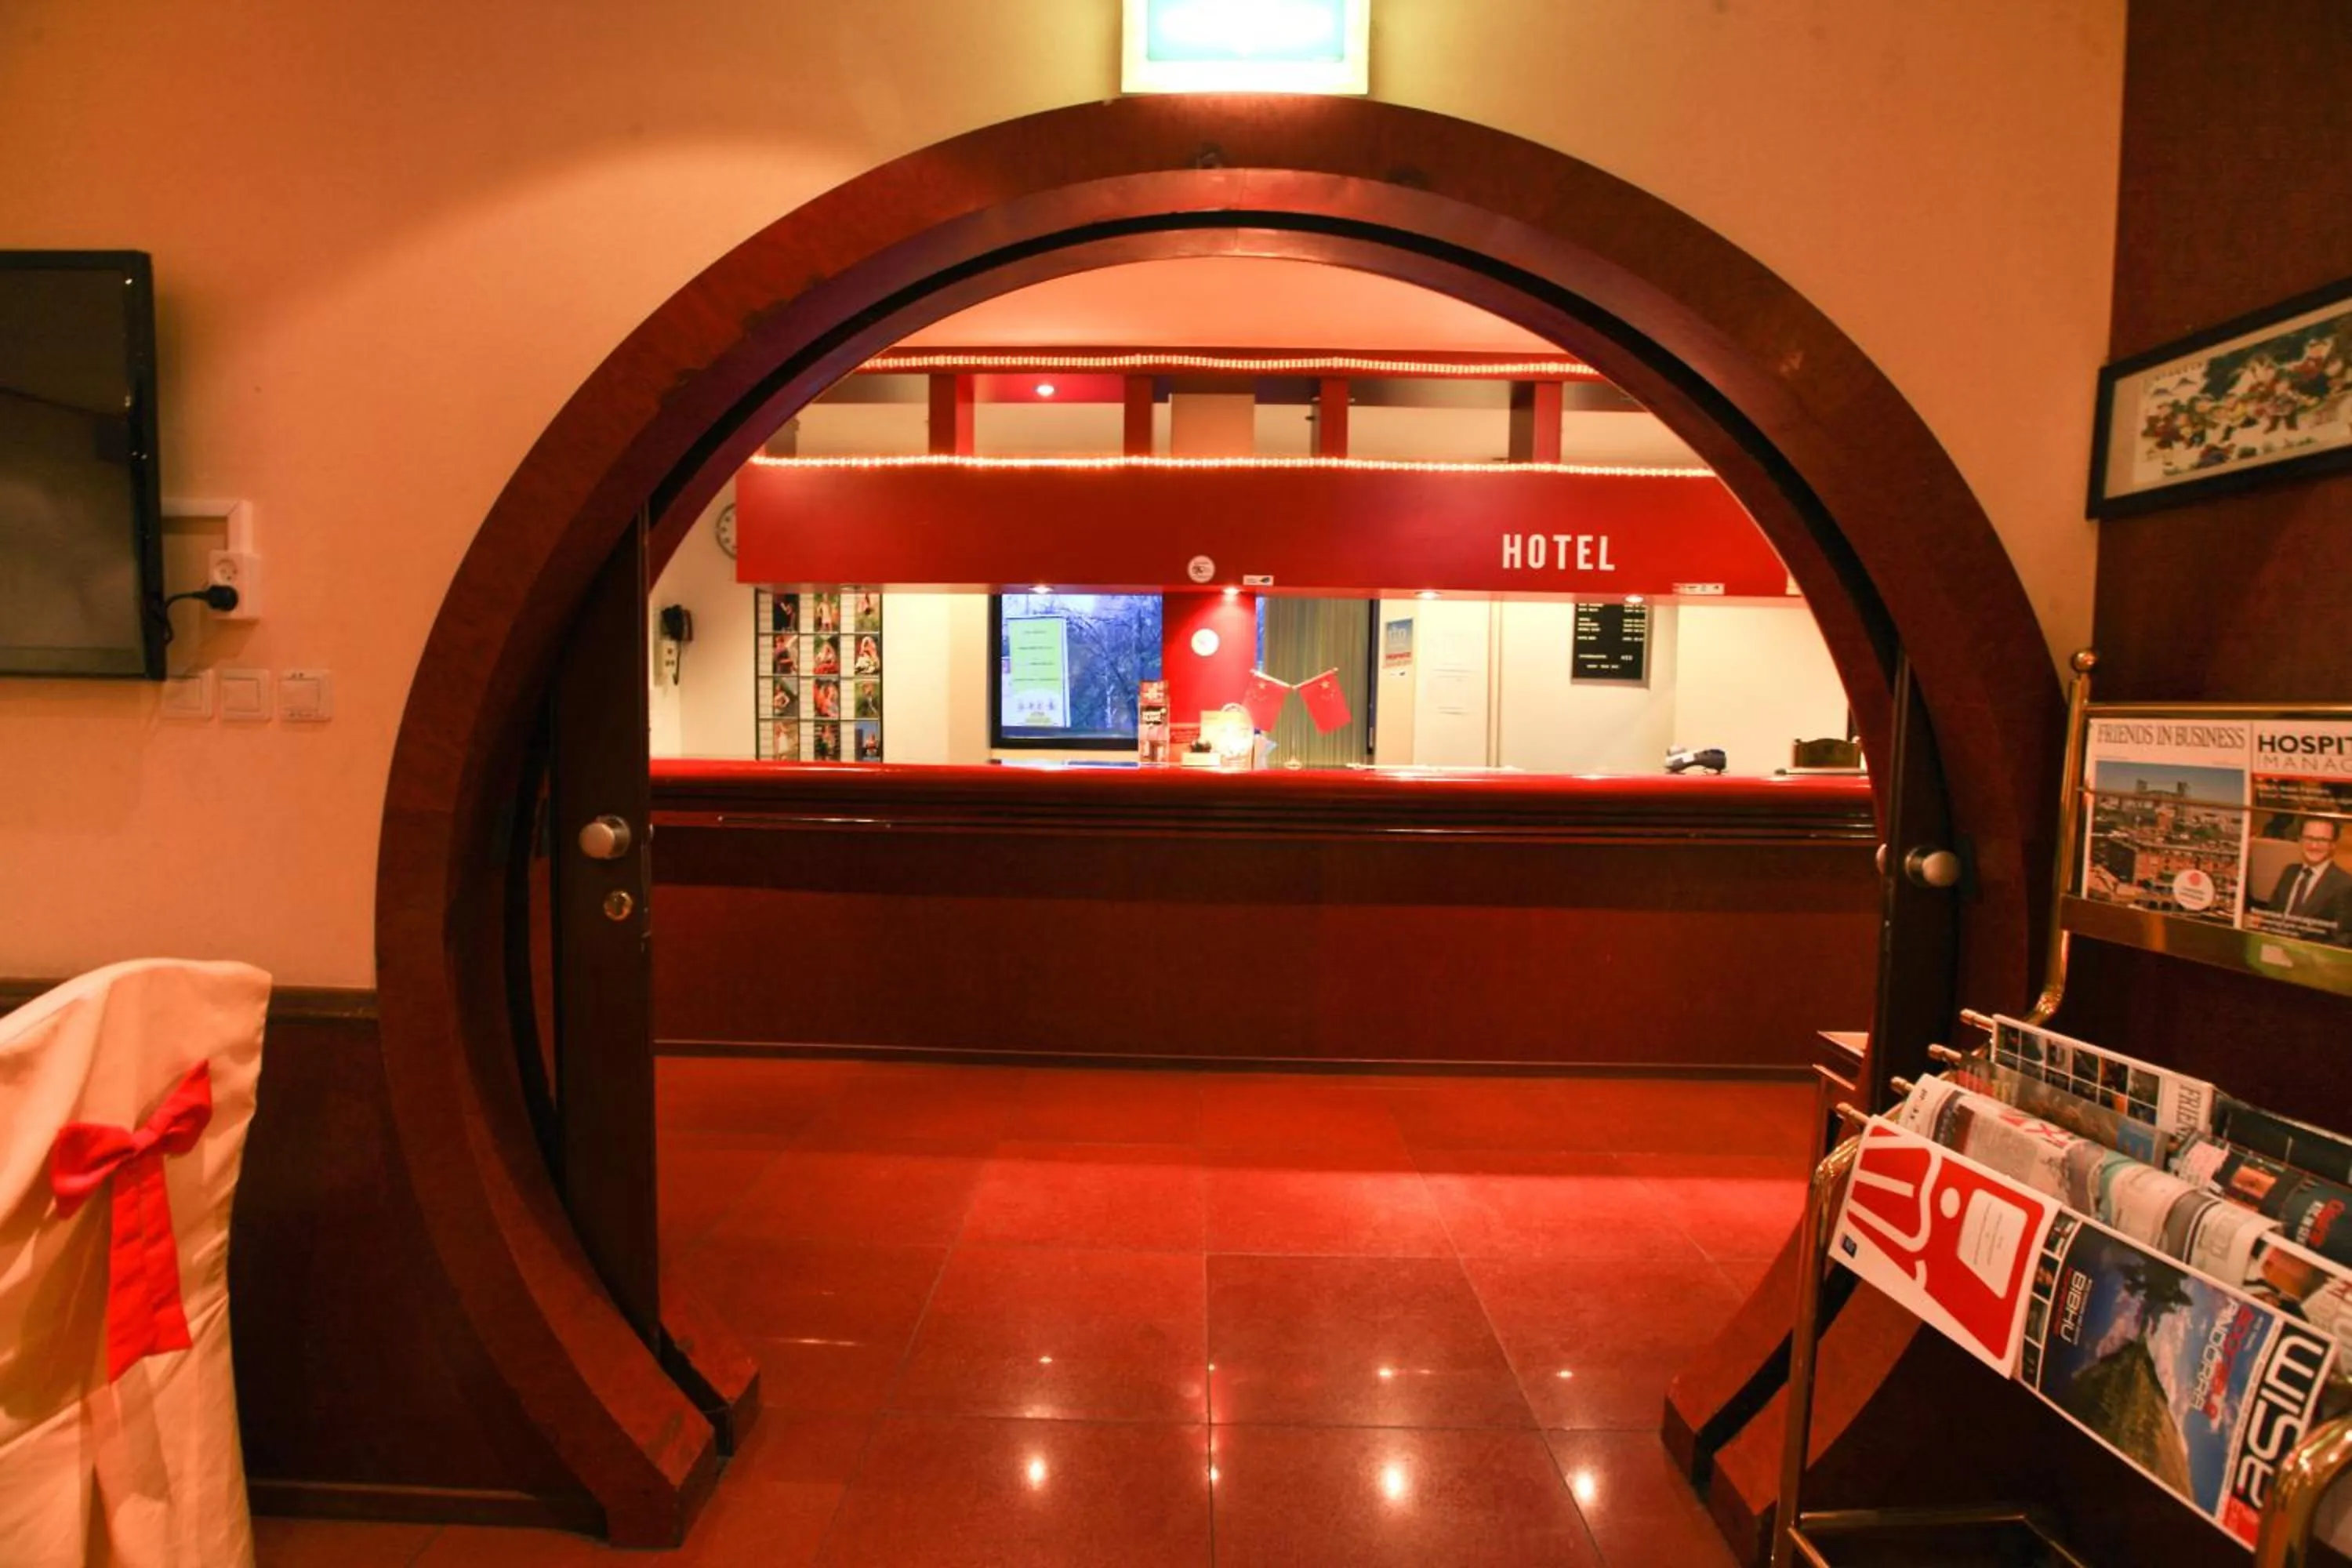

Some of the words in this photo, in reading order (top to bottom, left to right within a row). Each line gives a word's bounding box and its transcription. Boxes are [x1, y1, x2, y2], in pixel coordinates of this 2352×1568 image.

[1502, 534, 1615, 571] HOTEL
[2097, 724, 2154, 744] FRIENDS
[2156, 725, 2173, 746] IN
[2175, 726, 2245, 750] BUSINESS
